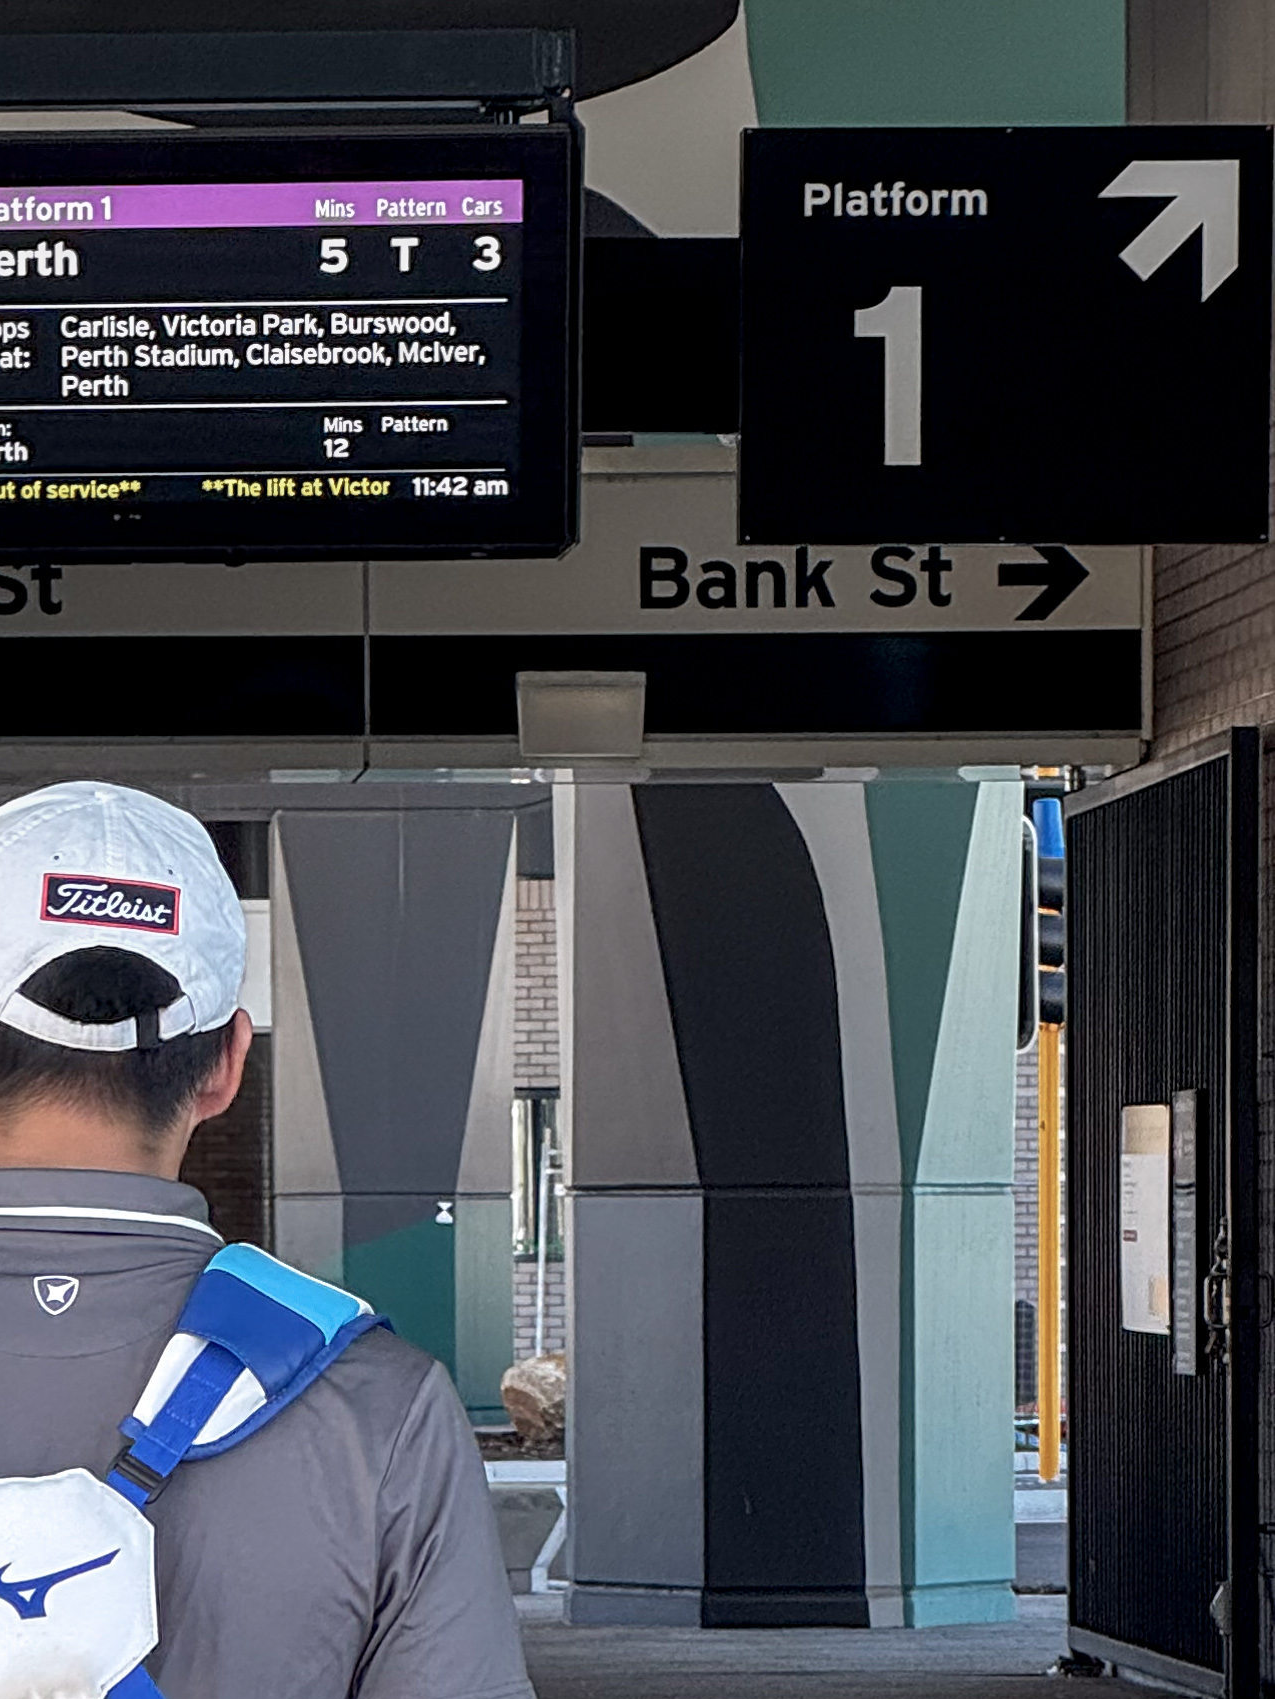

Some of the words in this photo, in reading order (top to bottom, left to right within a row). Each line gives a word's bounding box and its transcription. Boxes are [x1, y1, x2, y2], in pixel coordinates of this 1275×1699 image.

[100, 195, 112, 221] 1
[315, 198, 356, 219] Mins
[376, 197, 447, 218] Pattern
[461, 196, 503, 217] Cars
[804, 181, 988, 217] Platform
[319, 238, 348, 274] 5
[390, 237, 419, 272] T
[472, 235, 501, 271] 3
[60, 315, 157, 341] Carlisle,
[161, 313, 257, 337] Victoria
[262, 313, 325, 338] Park,
[330, 311, 456, 337] Burswood,
[61, 344, 129, 368] Perth
[134, 343, 240, 369] Stadium,
[245, 341, 392, 367] Claisebrook,
[398, 340, 486, 366] McIver,
[61, 374, 129, 397] Perth
[853, 285, 923, 466] 1
[323, 416, 364, 433] Mins
[381, 415, 449, 433] Pattern
[323, 437, 350, 458] 12
[20, 480, 42, 500] of
[266, 477, 296, 497] lift
[300, 477, 323, 497] at
[328, 476, 391, 496] Victor
[411, 476, 468, 497] 11:42
[473, 479, 509, 496] am
[639, 546, 836, 610] Bank
[869, 546, 953, 608] St
[47, 883, 172, 924] Titleist
